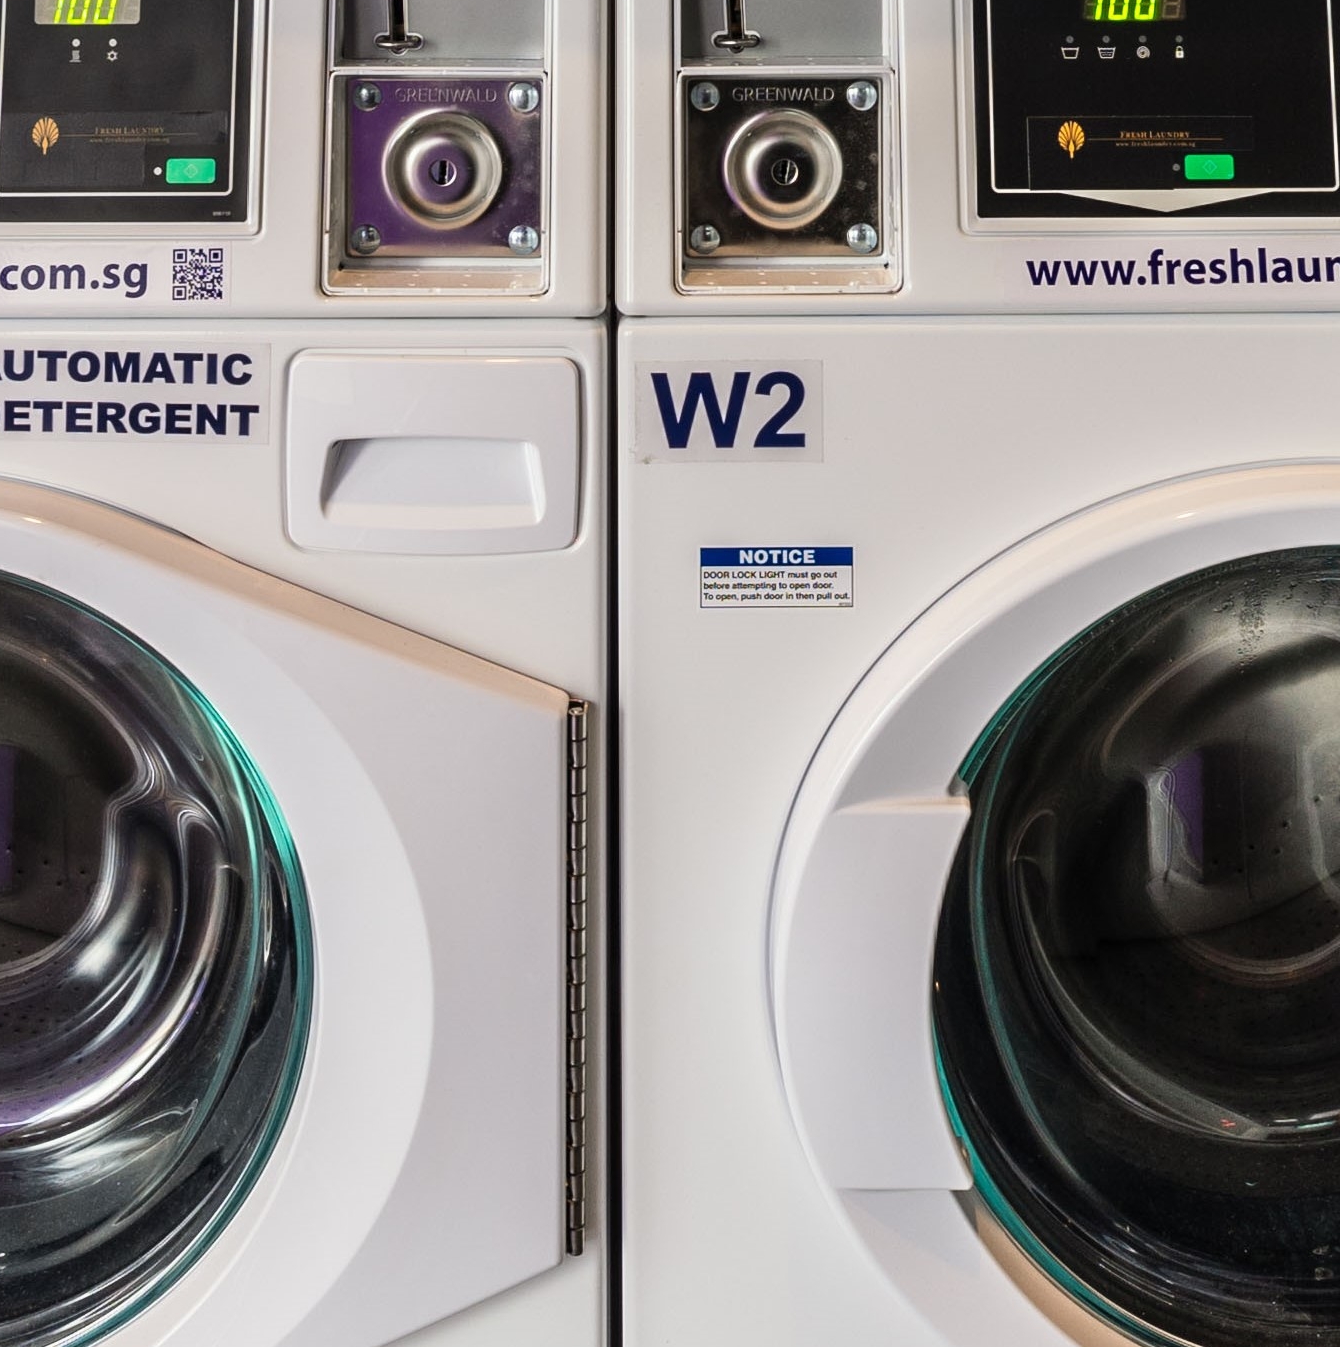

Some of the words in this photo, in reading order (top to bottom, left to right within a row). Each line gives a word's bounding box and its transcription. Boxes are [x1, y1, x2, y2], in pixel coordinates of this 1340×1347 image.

[395, 88, 497, 103] GREENWALD
[732, 87, 834, 103] GREENWALD
[1120, 131, 1147, 139] FRESH
[1150, 131, 1190, 139] LAUNDRY
[651, 372, 805, 448] W2
[740, 550, 815, 564] NOTICE
[704, 571, 729, 579] DOOR
[732, 571, 756, 579] LOCK
[759, 571, 785, 579] LIGHT
[788, 571, 808, 579] must
[790, 583, 810, 591] open
